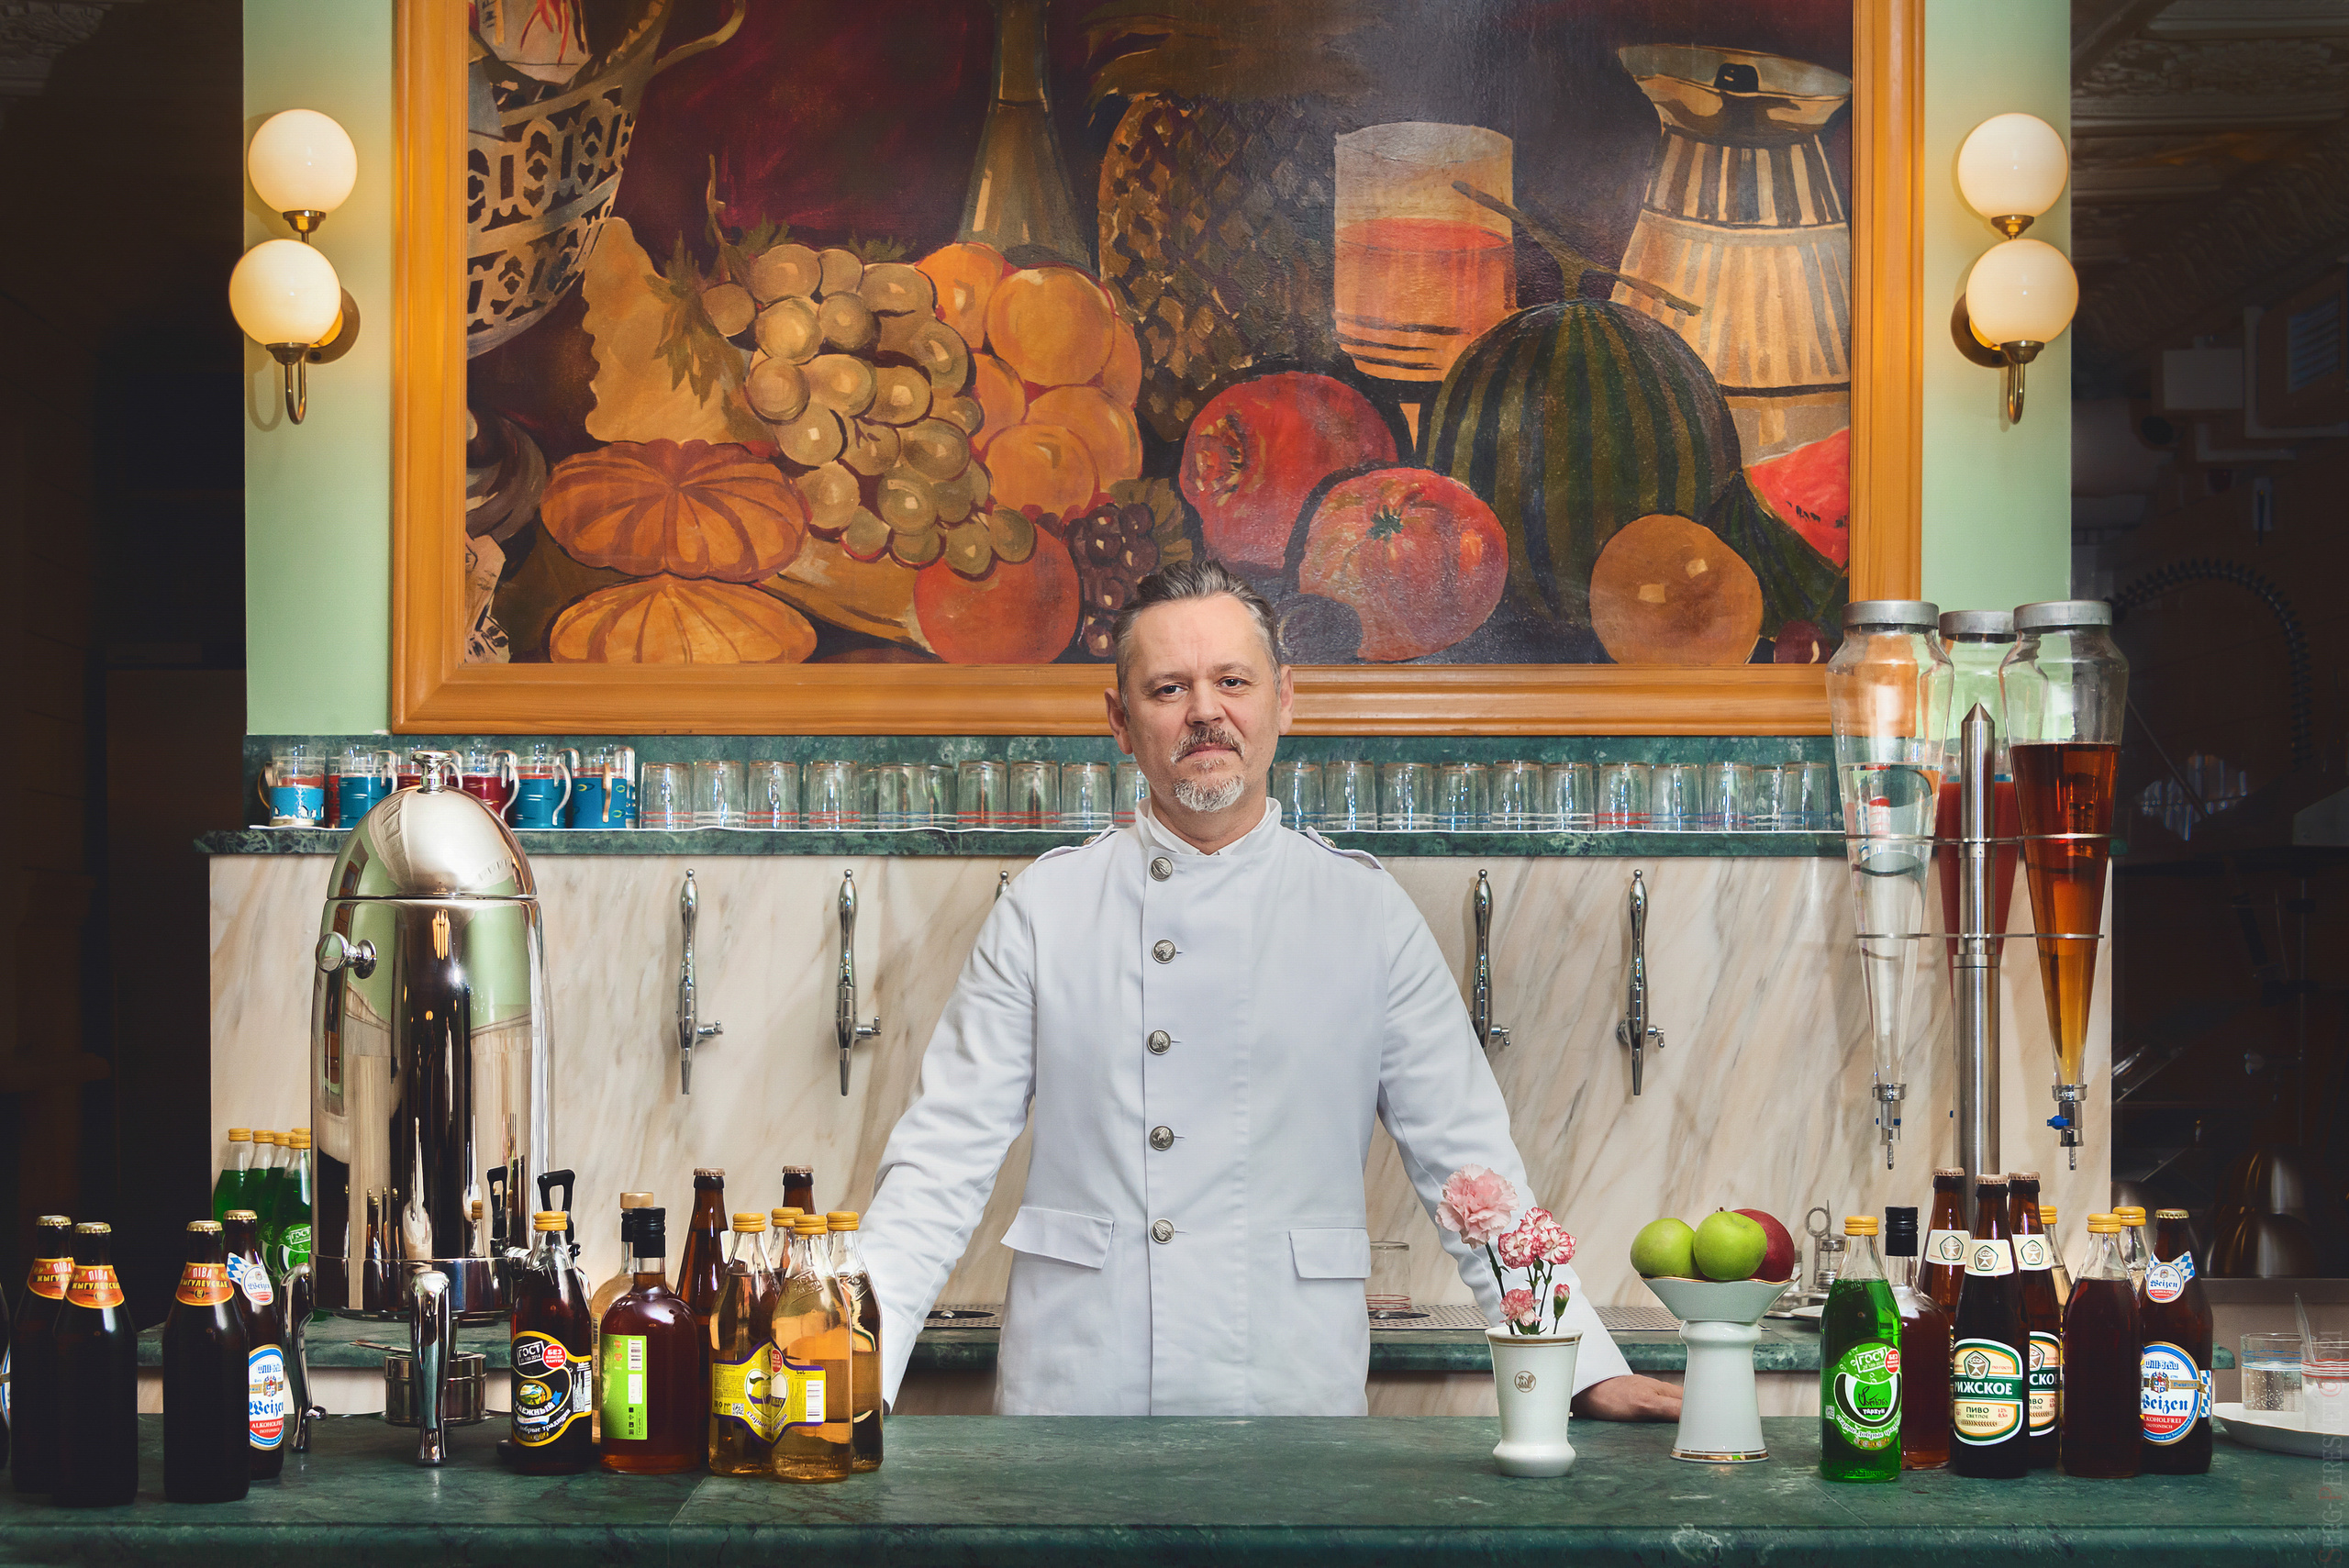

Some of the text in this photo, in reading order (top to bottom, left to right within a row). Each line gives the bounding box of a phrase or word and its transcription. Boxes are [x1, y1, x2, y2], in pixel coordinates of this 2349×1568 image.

[88, 1270, 108, 1281] ПІВА
[193, 1267, 212, 1279] ПІВА
[518, 1344, 540, 1358] ГОСТ
[1858, 1349, 1885, 1365] ГОСТ
[2030, 1373, 2058, 1385] СКОЕ
[1954, 1382, 2013, 1395] РИЖСКОЕ
[515, 1401, 556, 1417] ТАЕЖНЫЙ
[2143, 1416, 2182, 1424] LKOHOLFREI
